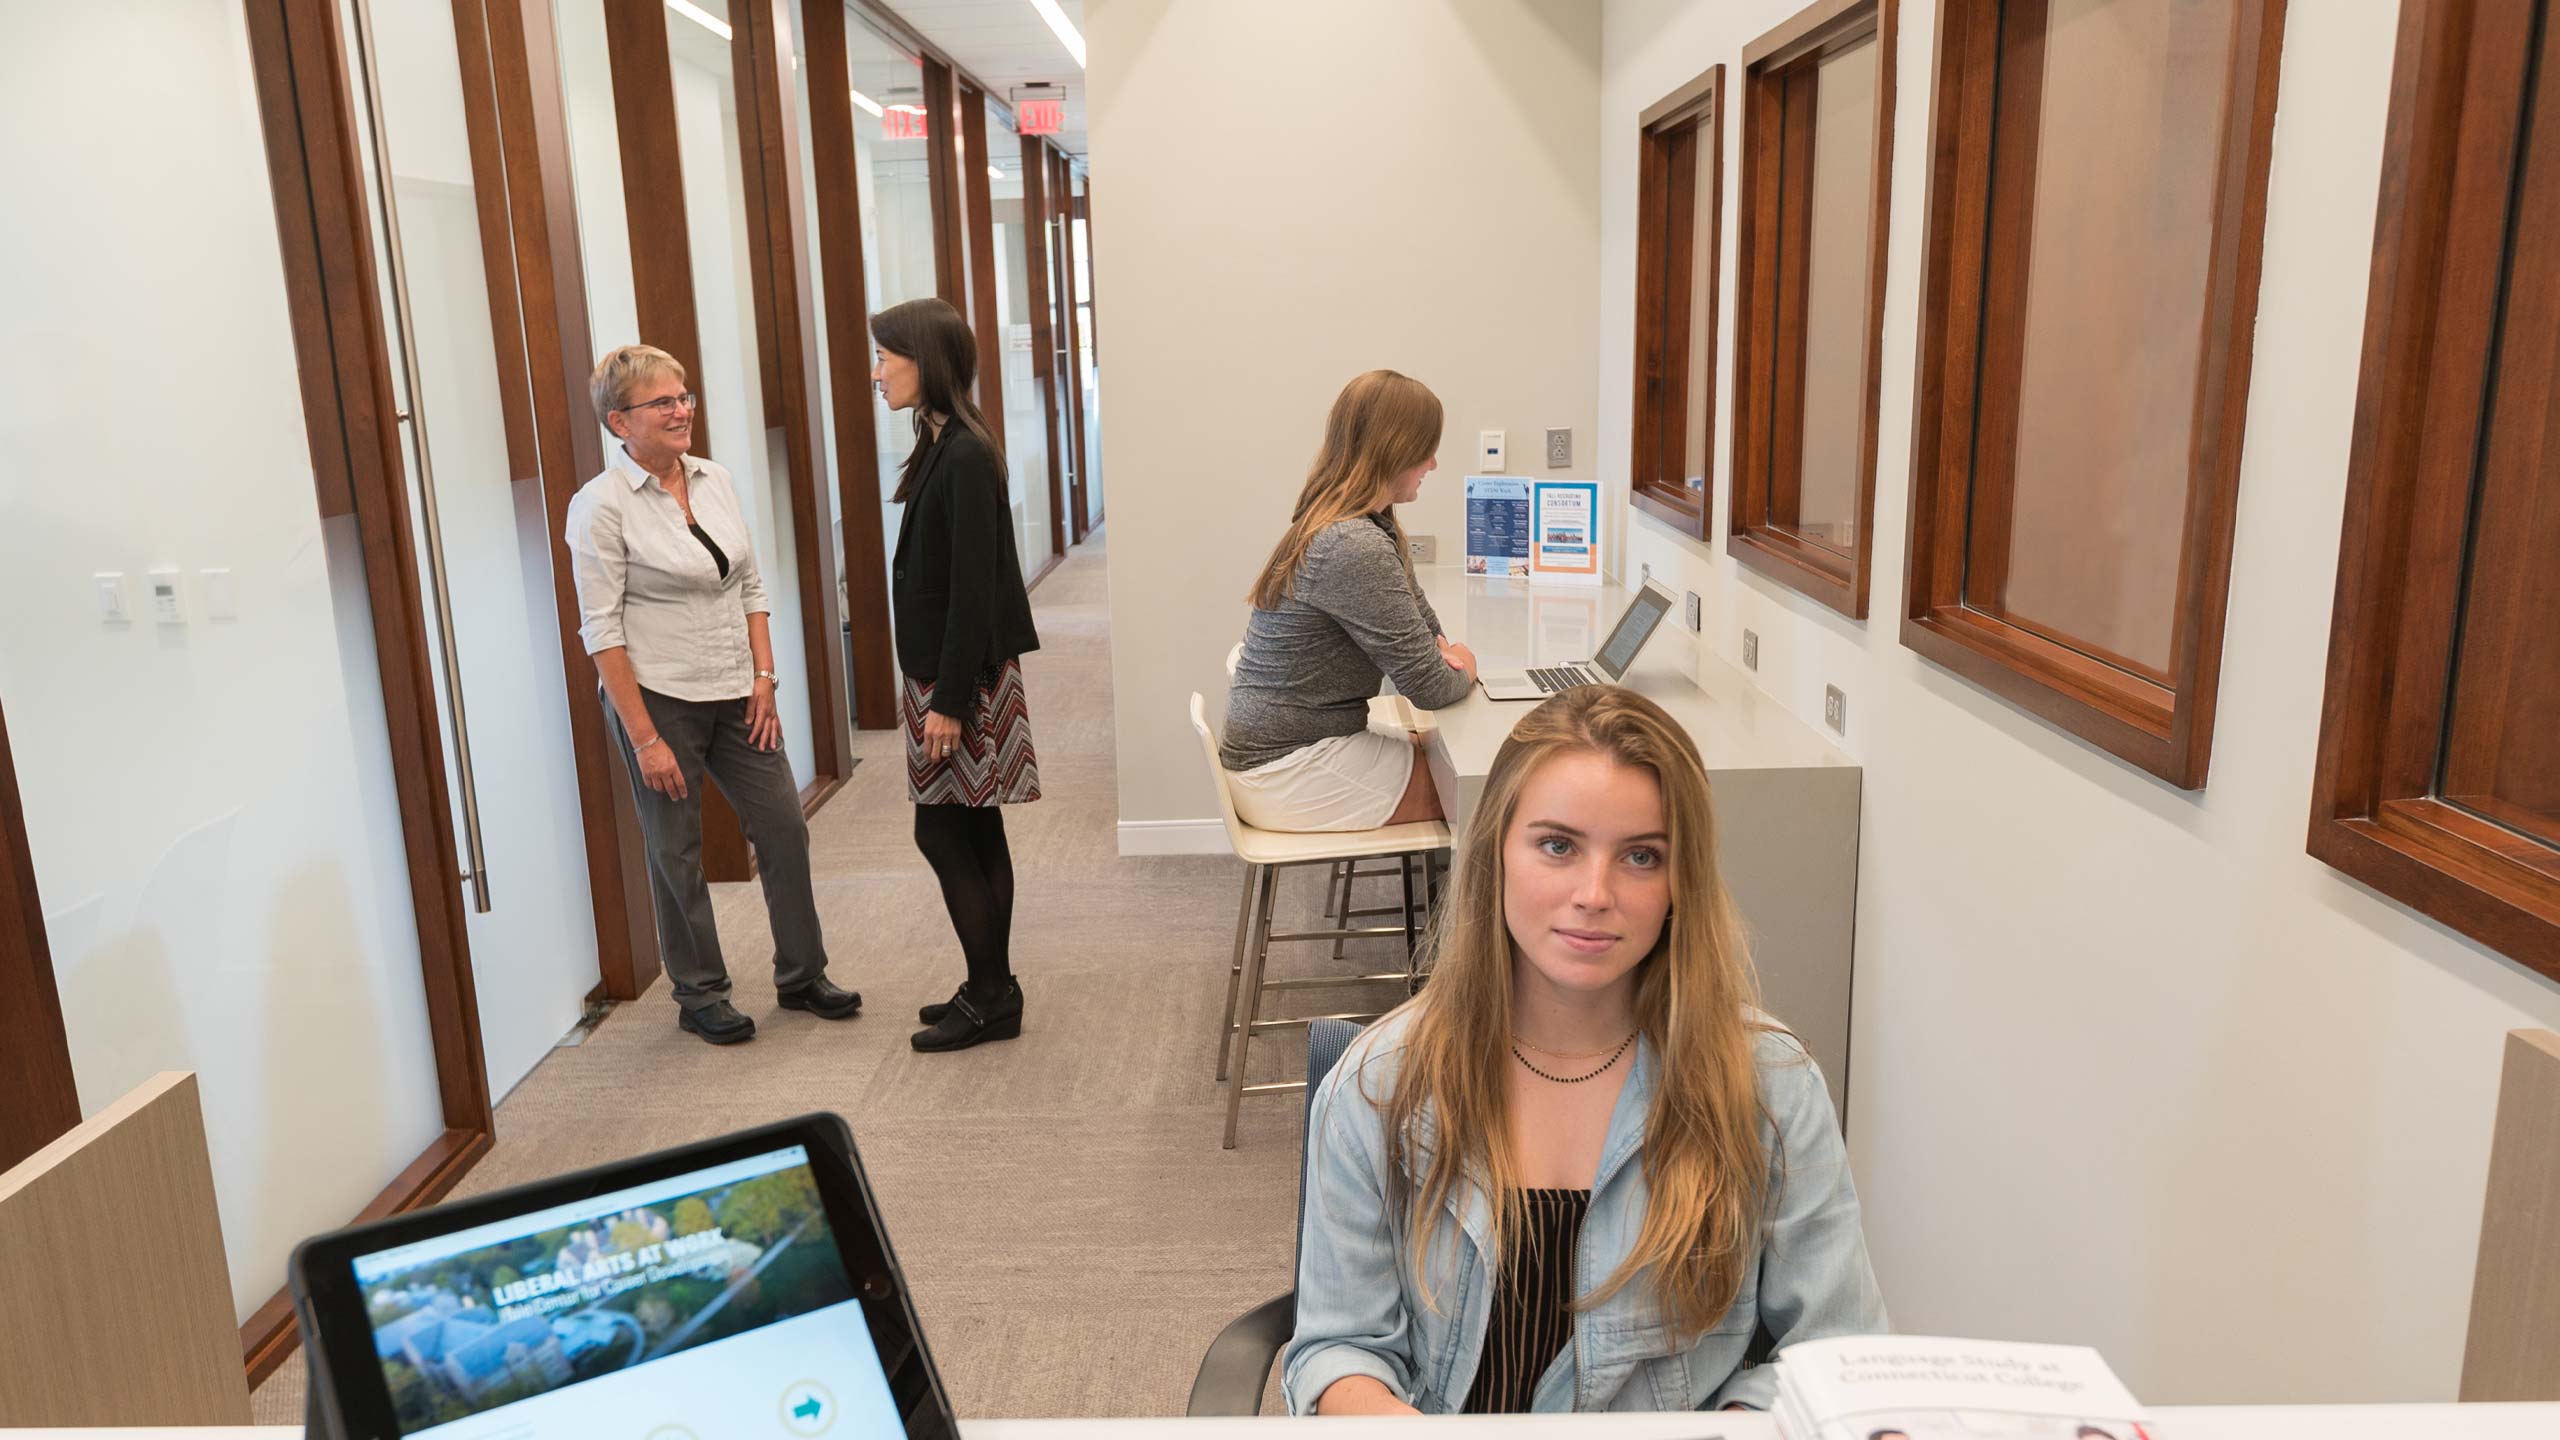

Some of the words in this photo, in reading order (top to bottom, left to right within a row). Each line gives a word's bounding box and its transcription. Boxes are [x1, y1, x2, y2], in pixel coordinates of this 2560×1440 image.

[1021, 102, 1057, 130] EXIT
[492, 1267, 581, 1306] LIBERAL
[583, 1252, 635, 1281] ARTS
[638, 1244, 662, 1267] AT
[663, 1227, 725, 1258] WORK
[533, 1291, 580, 1315] Center
[580, 1282, 602, 1301] for
[601, 1269, 648, 1297] Career
[1839, 1352, 1956, 1367] Language
[1959, 1354, 2031, 1372] Study
[2037, 1359, 2062, 1373] at
[1839, 1369, 1988, 1384] Connecticut
[1992, 1372, 2086, 1393] College
